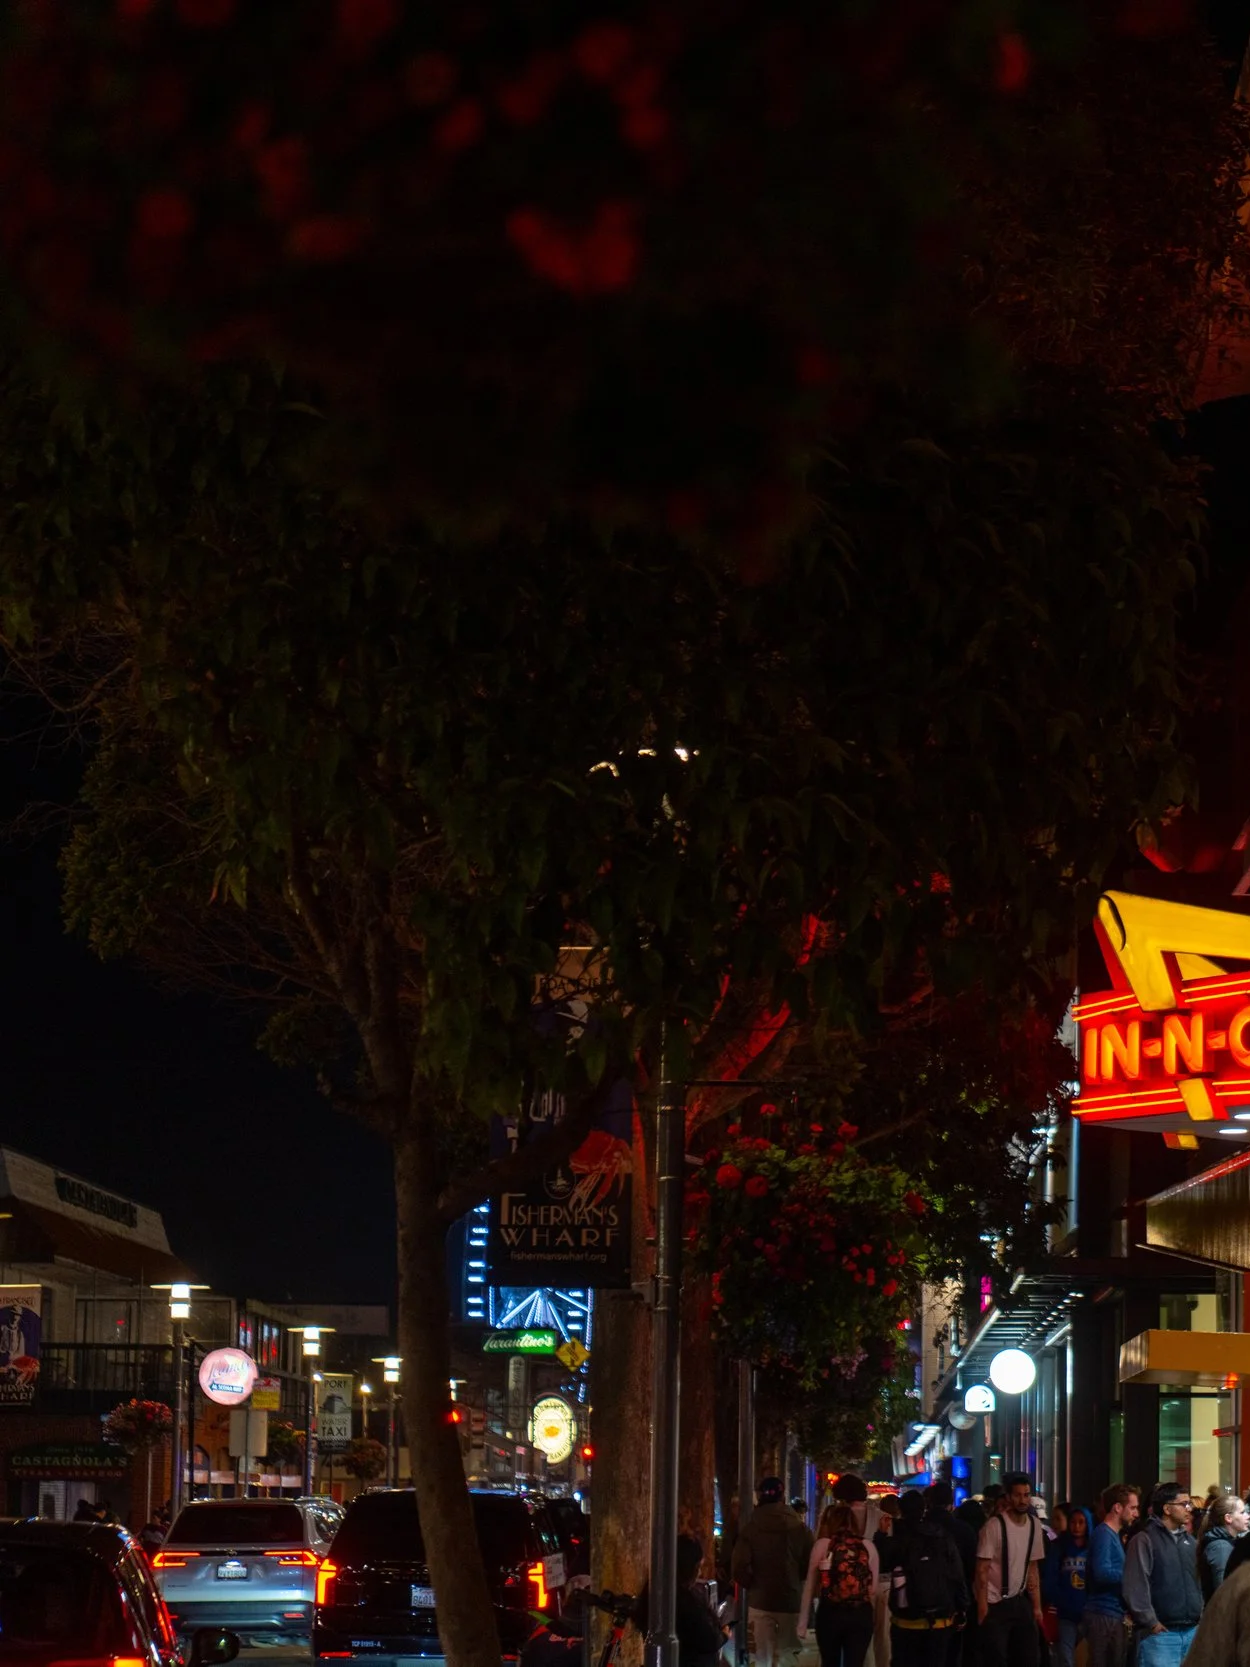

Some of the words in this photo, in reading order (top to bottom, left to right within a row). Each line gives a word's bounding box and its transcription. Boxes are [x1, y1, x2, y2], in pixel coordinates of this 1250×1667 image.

[500, 1192, 619, 1226] FISHERMAN'S
[500, 1228, 620, 1247] WHARF
[510, 1251, 607, 1263] fishermanswharf.org
[483, 1333, 554, 1350] Tarantino's
[324, 1379, 346, 1388] PORT
[321, 1427, 347, 1437] TAXI
[12, 1456, 128, 1466] CASTAGNOLA'S
